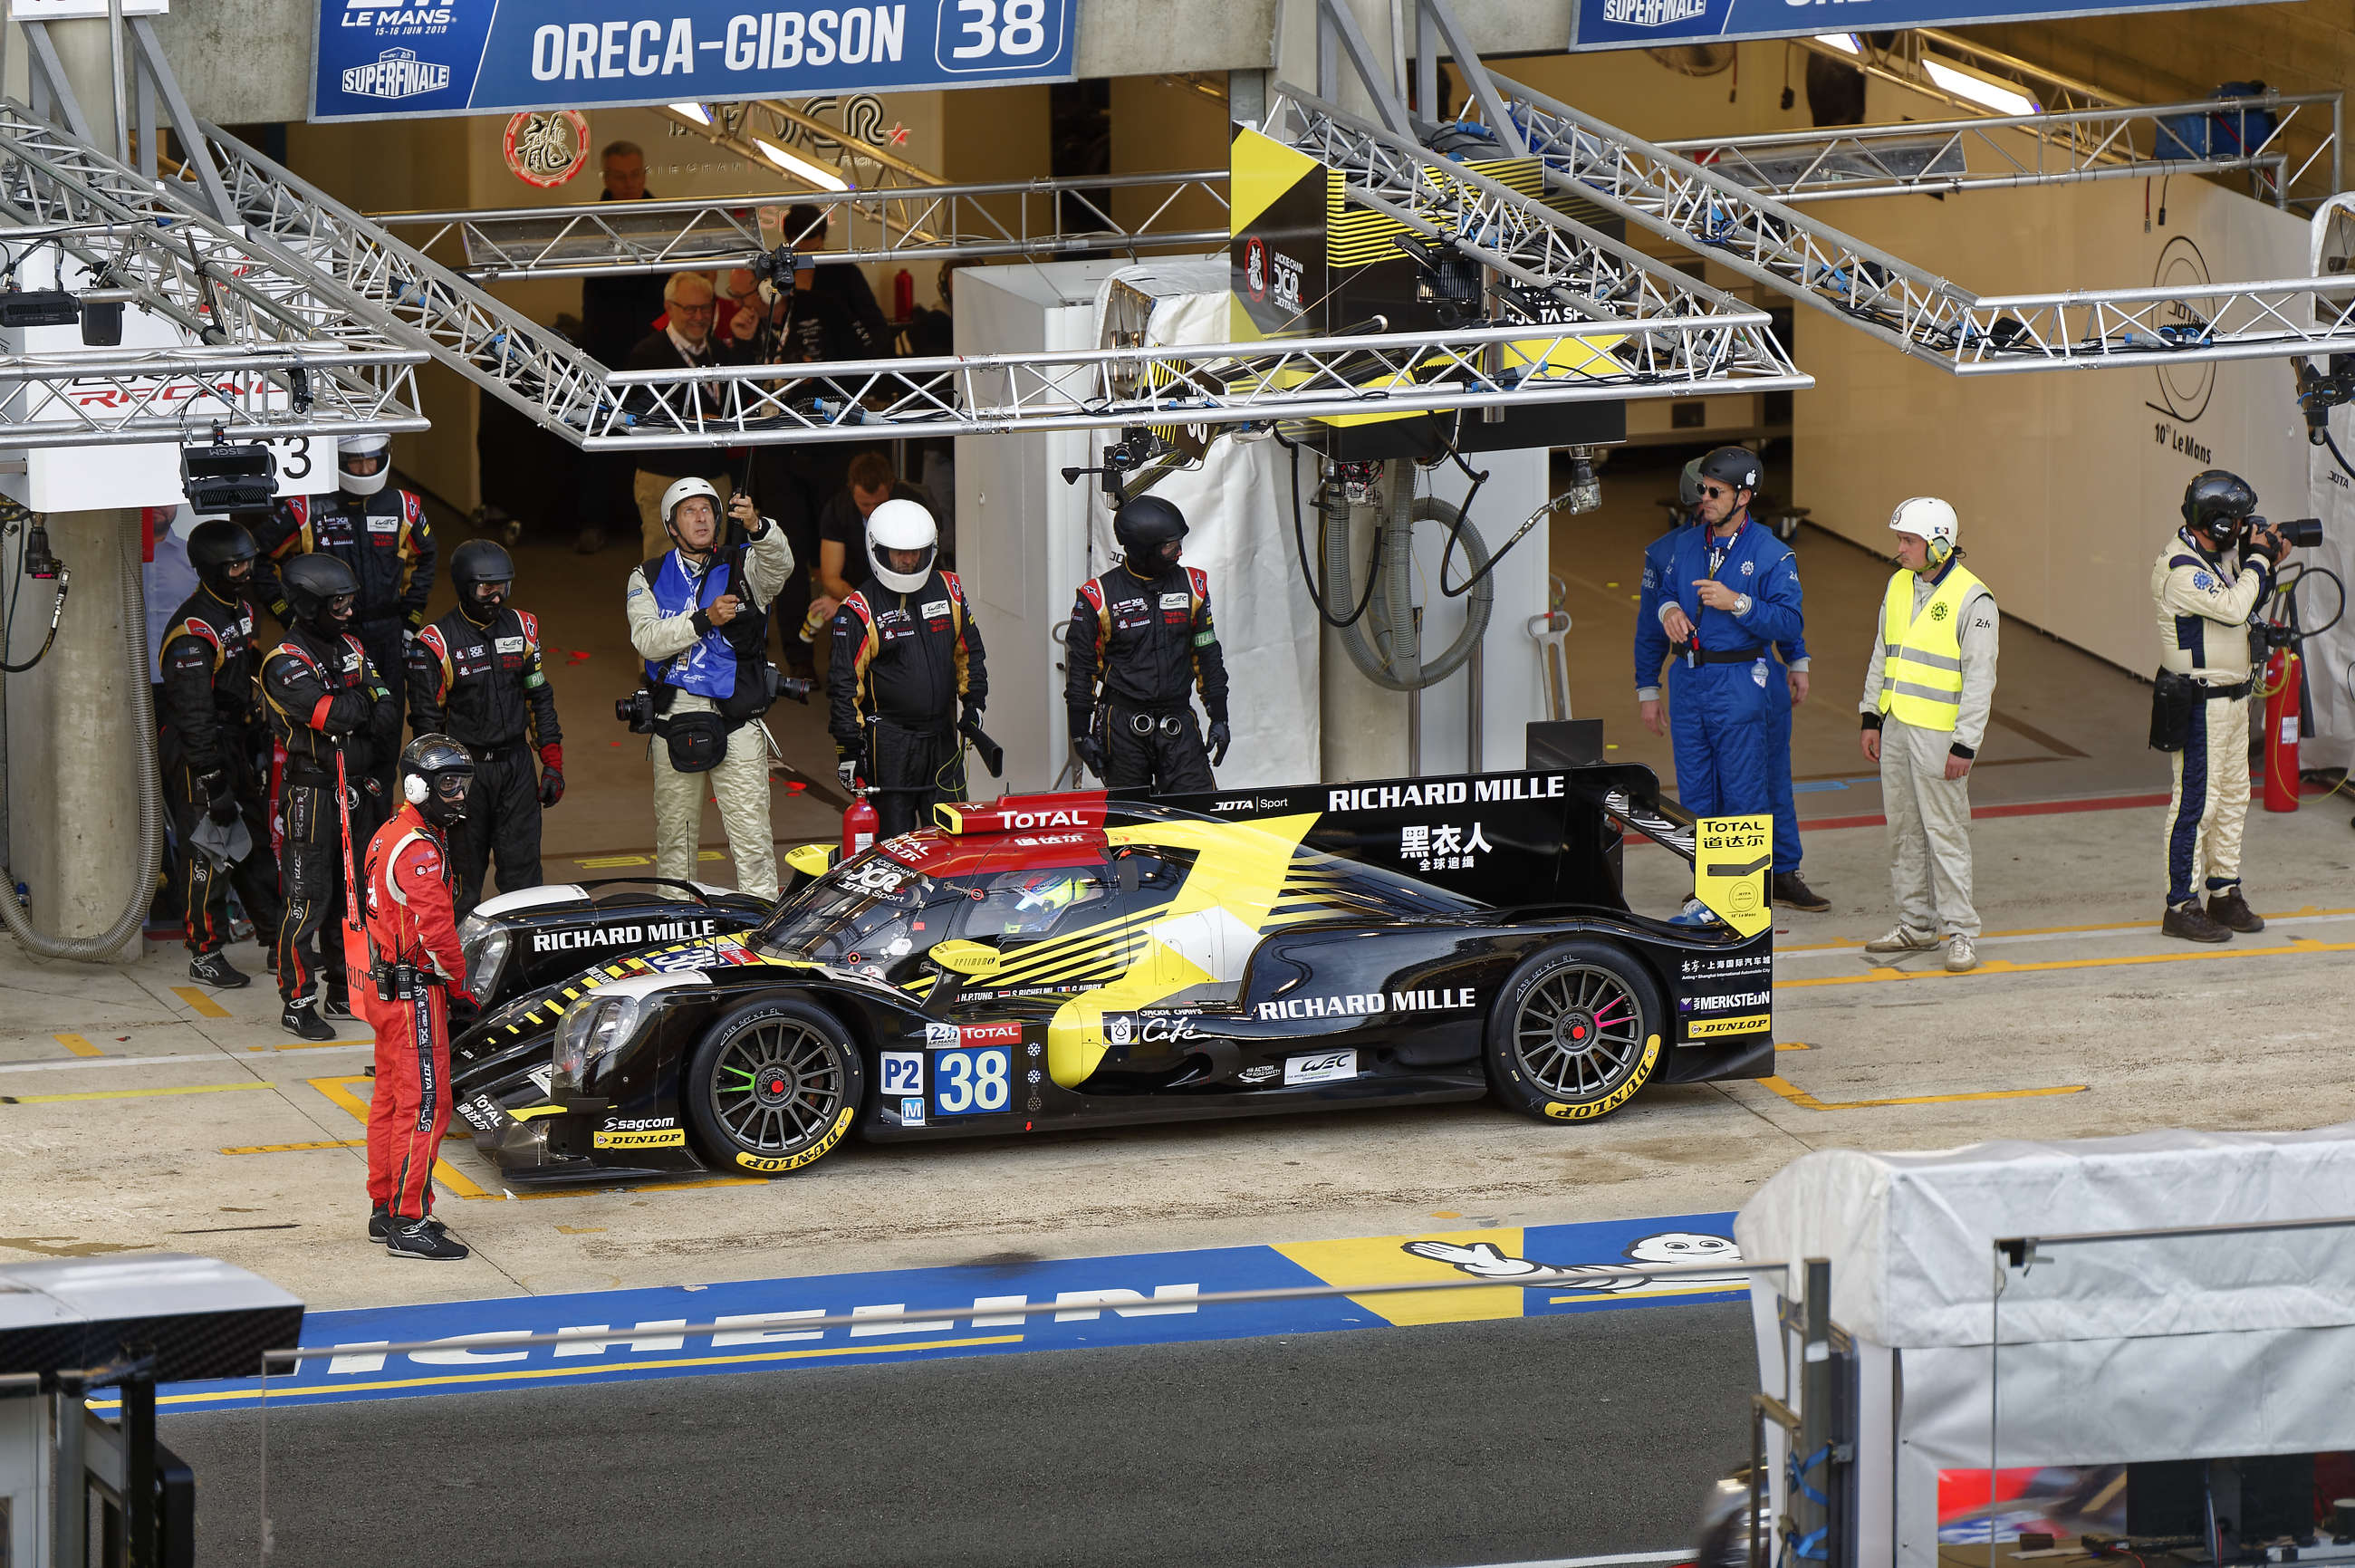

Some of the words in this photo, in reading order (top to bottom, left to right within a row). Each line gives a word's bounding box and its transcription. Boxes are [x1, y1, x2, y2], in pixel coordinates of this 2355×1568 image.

[341, 12, 374, 26] LE
[377, 9, 451, 25] MANS
[1606, 0, 1704, 24] SUPERFINALE
[375, 27, 399, 35] 15-16
[402, 26, 422, 34] JUIN
[425, 25, 447, 34] 2019
[531, 4, 905, 81] ORECA-GIBSON
[952, 0, 1045, 59] 38
[344, 61, 447, 97] SUPERFINALE
[2173, 429, 2184, 453] Le
[2186, 436, 2212, 465] Mans
[1210, 800, 1254, 812] JOTA
[1260, 797, 1288, 810] Sport
[1329, 782, 1467, 813] RICHARD
[1475, 775, 1565, 803] MILLE
[997, 810, 1088, 830] TOTAL
[1703, 821, 1765, 833] TOTAL
[1400, 822, 1493, 860] 黑衣人
[1703, 834, 1765, 849] 道达尔
[892, 865, 917, 879] CHAN
[837, 880, 870, 895] JOTA
[872, 890, 905, 902] Sport
[534, 925, 641, 952] RICHARD
[648, 919, 716, 942] MILLE
[1259, 993, 1385, 1021] RICHARD
[1391, 987, 1475, 1012] MILLE
[963, 1026, 1019, 1040] TOTAL
[1704, 1019, 1767, 1033] DUNLOP
[885, 1059, 919, 1090] P2
[1301, 1053, 1351, 1073] WEC
[939, 1051, 1009, 1112] 38
[1555, 1063, 1650, 1119] DUNLOP
[474, 1093, 503, 1127] TOTAL
[906, 1101, 922, 1118] M
[610, 1133, 682, 1144] DUNLOP
[745, 1128, 839, 1169] DUNLOP
[246, 1282, 1199, 1378] ICHELIN
